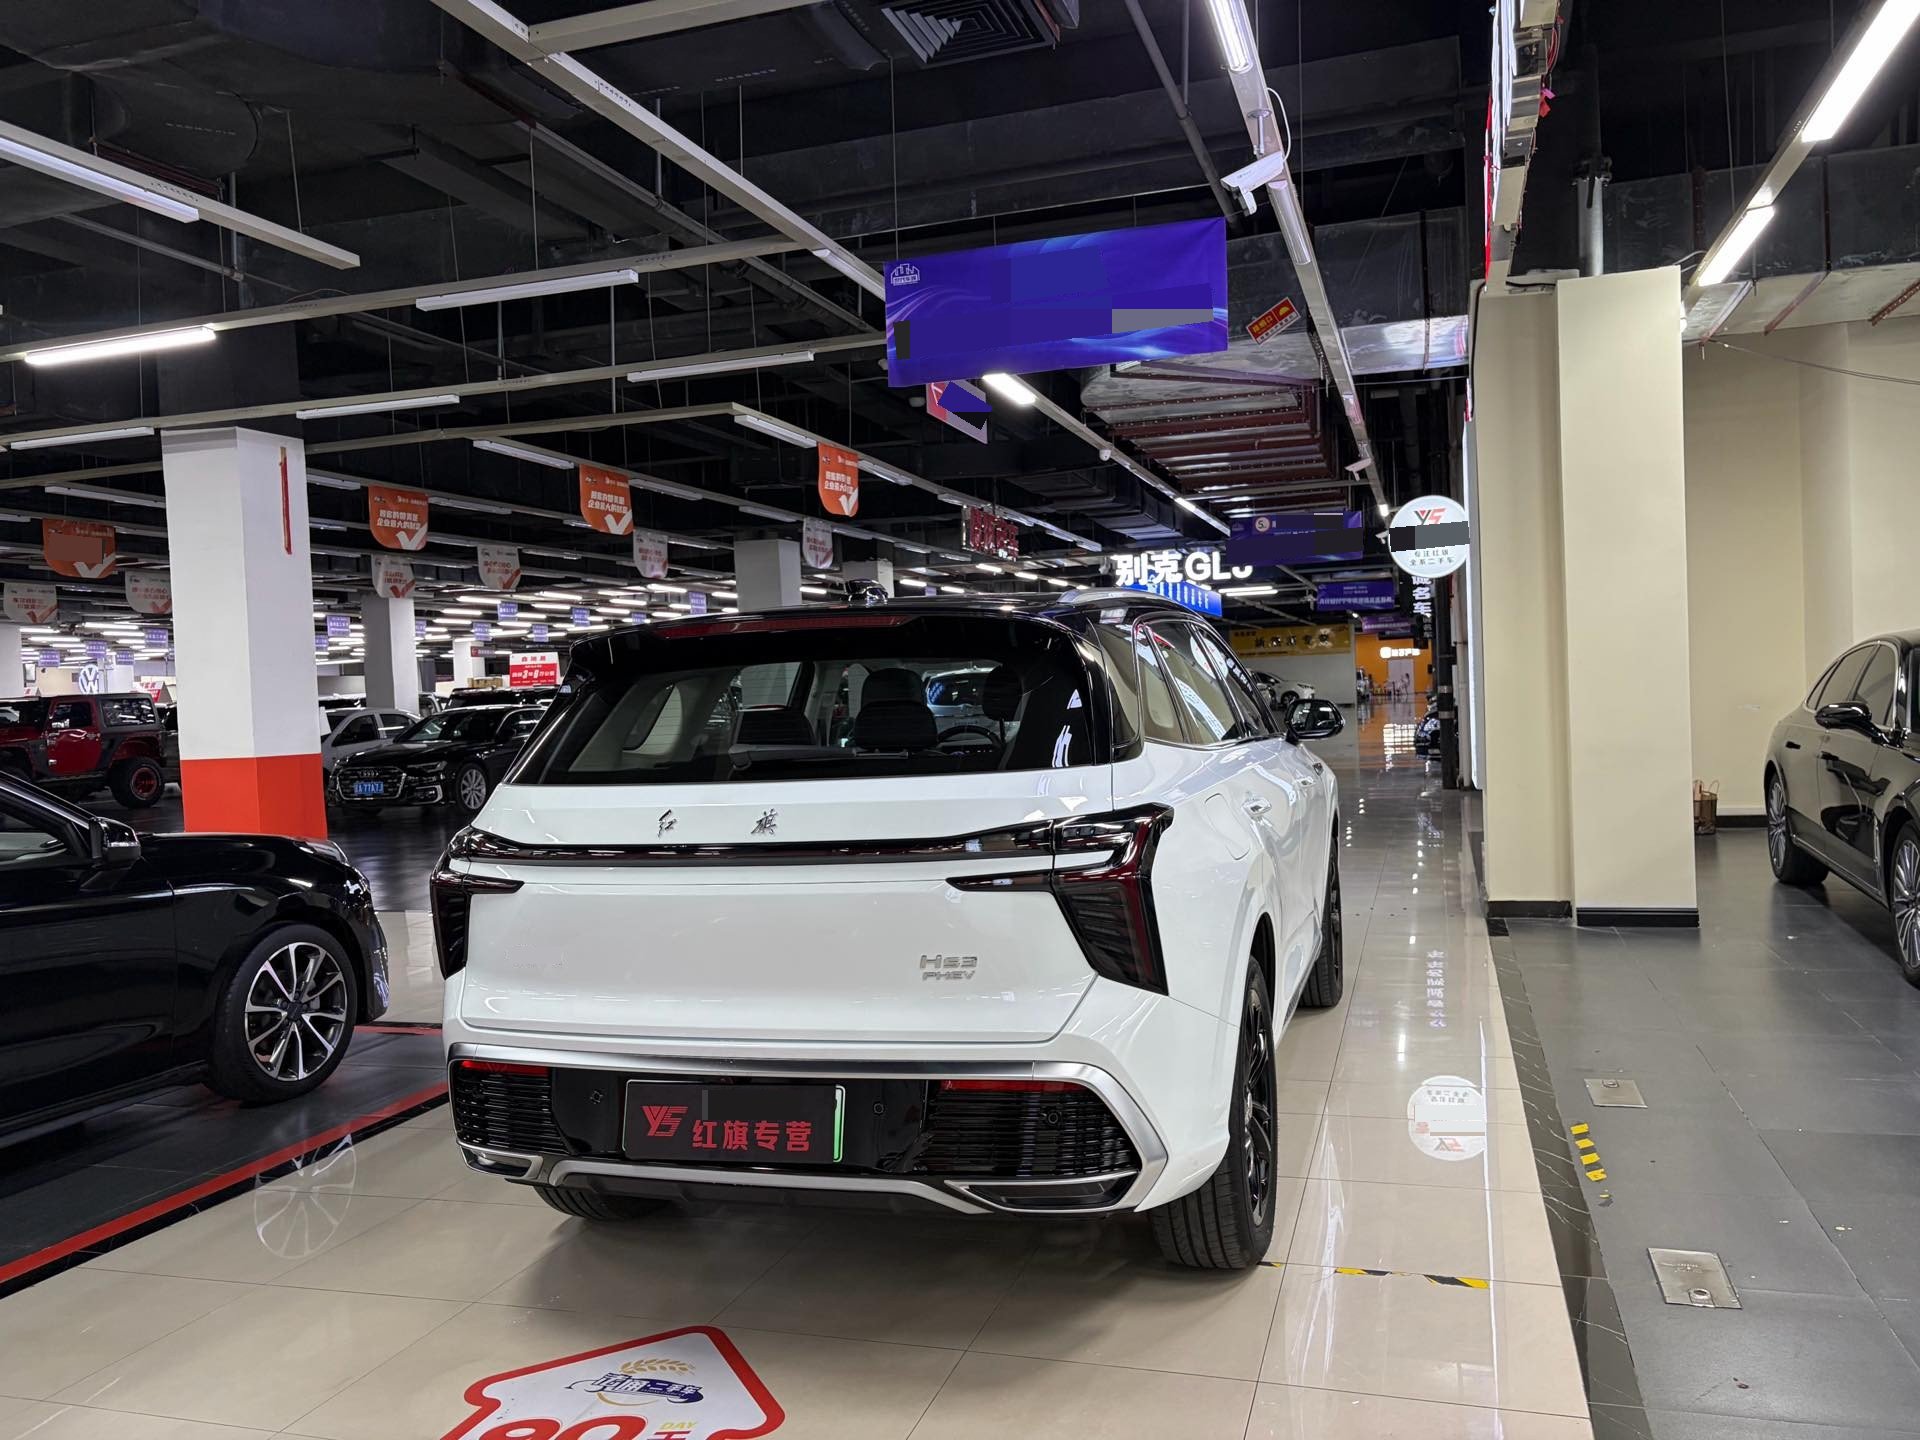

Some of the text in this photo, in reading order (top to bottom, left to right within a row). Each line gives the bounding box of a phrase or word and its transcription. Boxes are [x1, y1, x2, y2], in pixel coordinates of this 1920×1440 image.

[922, 970, 975, 980] PHEV
[692, 1120, 812, 1151] 红旗专营
[660, 1420, 698, 1430] DAY
